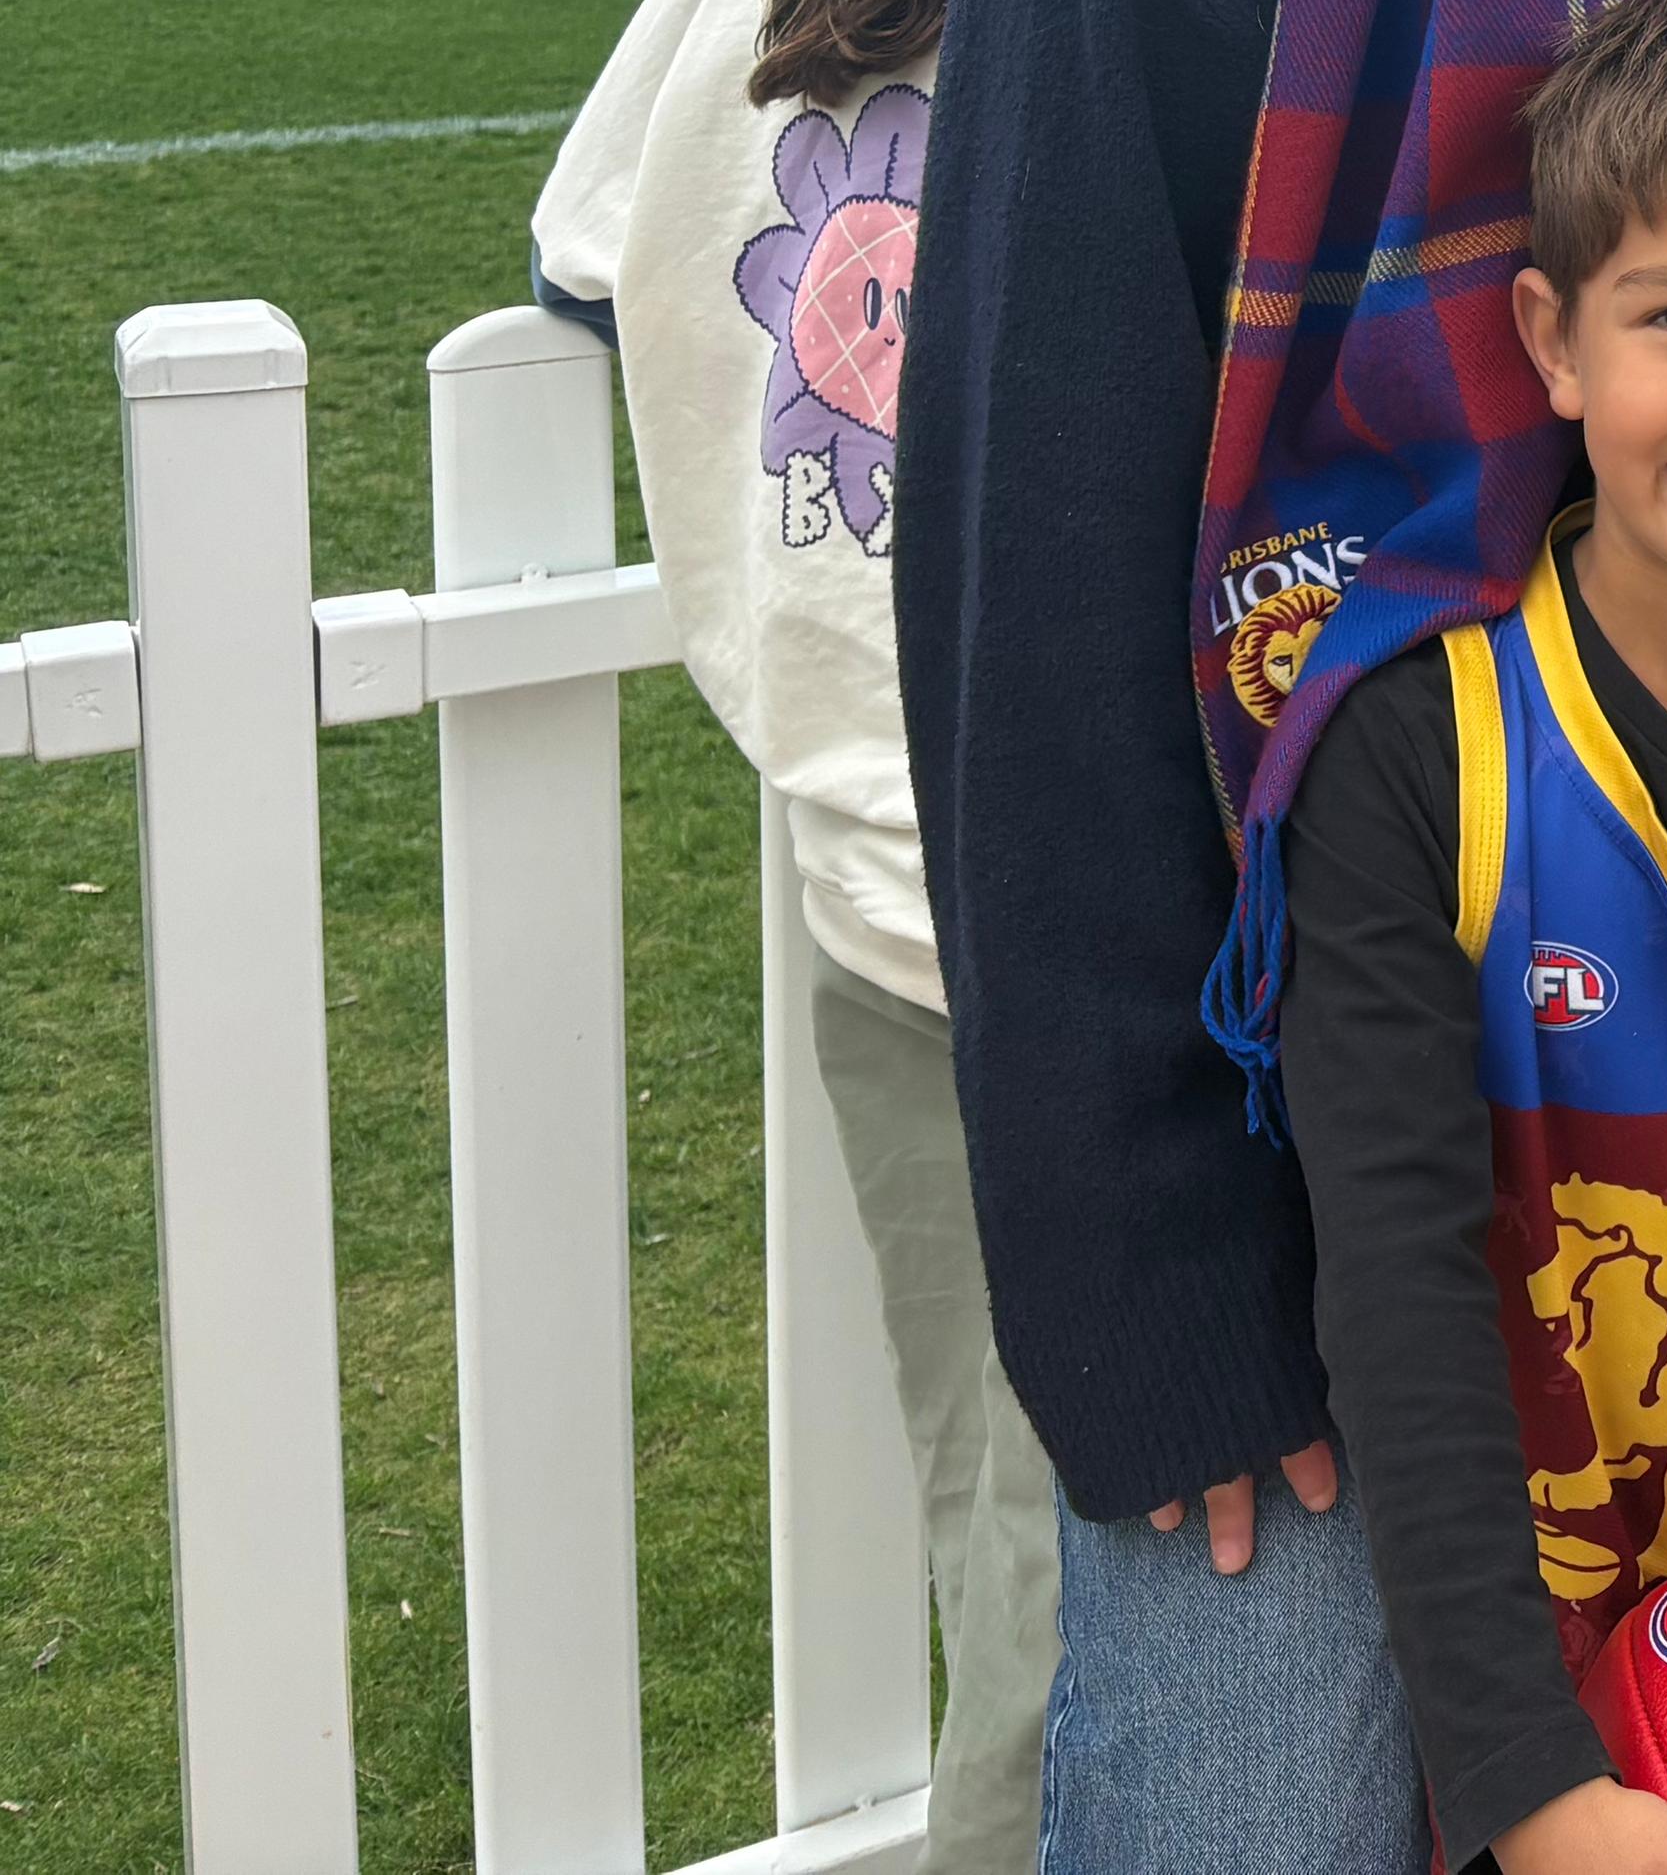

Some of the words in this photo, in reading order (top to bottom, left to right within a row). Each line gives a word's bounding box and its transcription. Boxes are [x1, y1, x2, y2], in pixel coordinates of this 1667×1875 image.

[1220, 521, 1333, 573] RISBANE
[1209, 536, 1368, 638] LIONS
[1532, 966, 1606, 1017] FL
